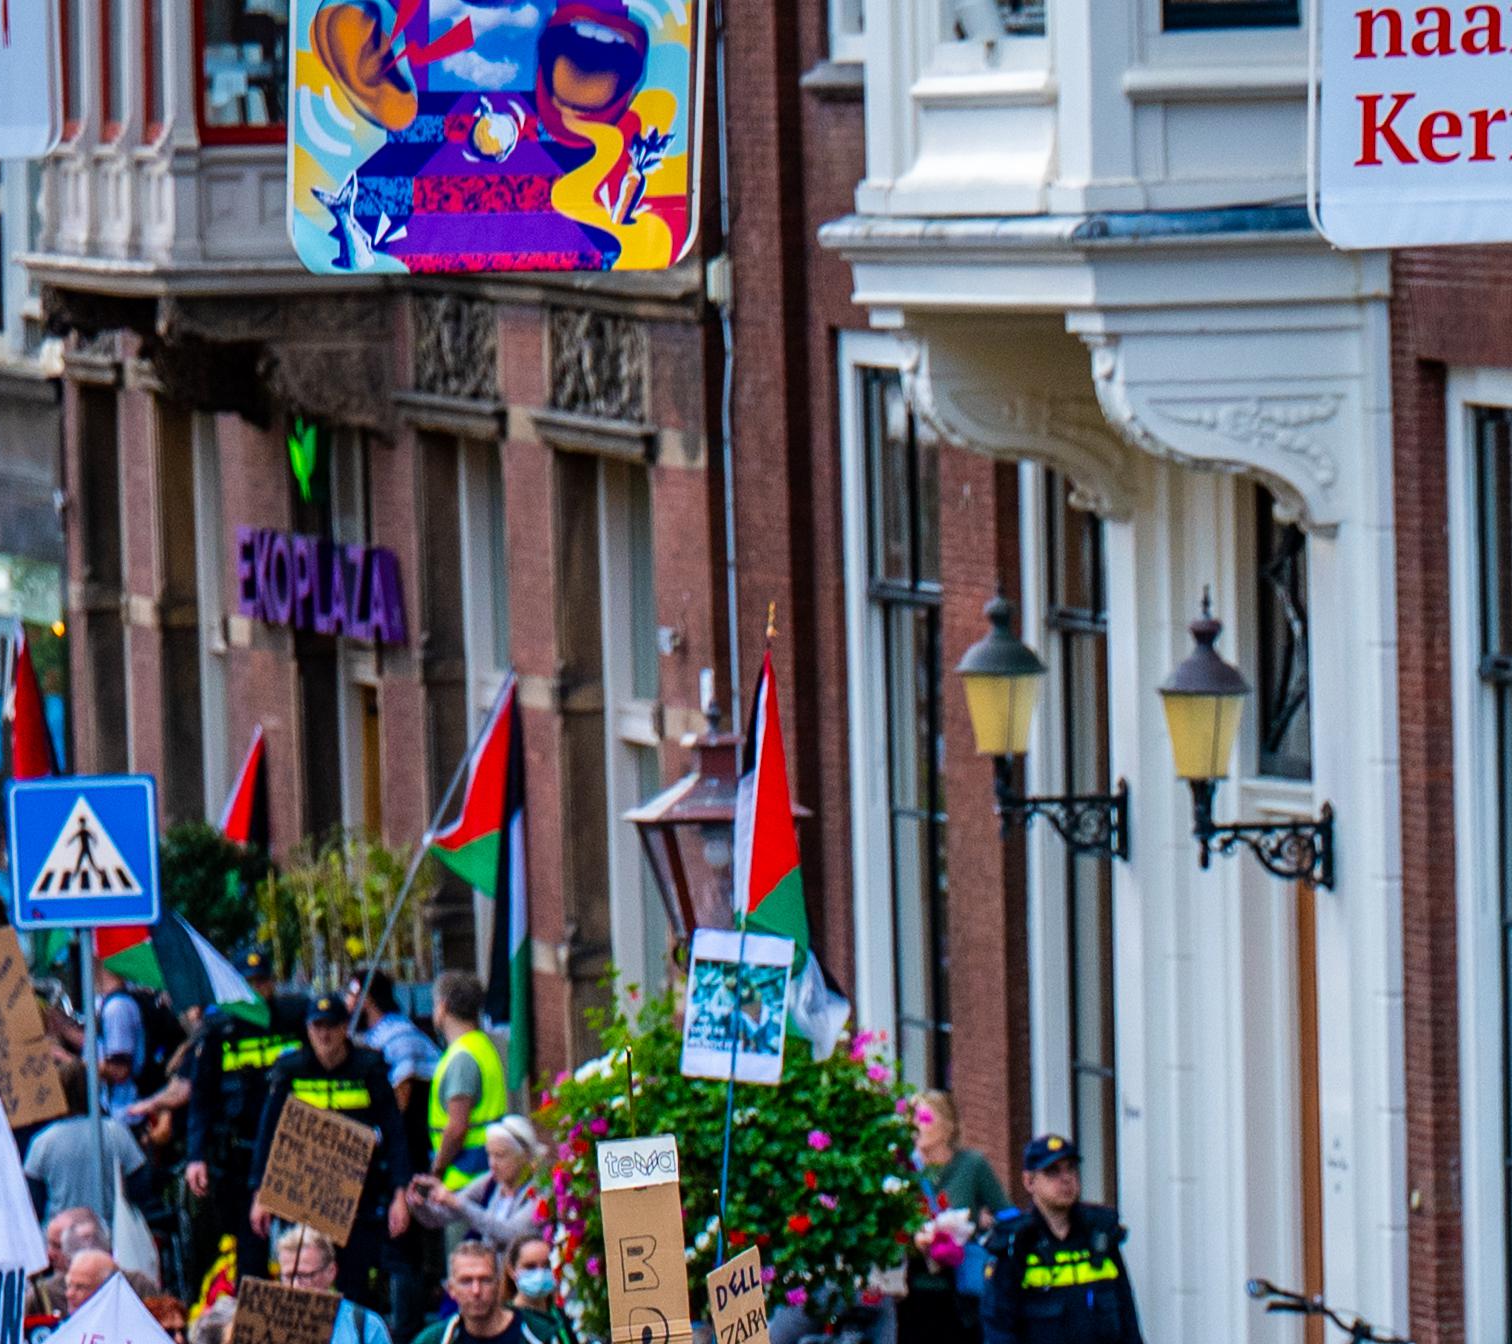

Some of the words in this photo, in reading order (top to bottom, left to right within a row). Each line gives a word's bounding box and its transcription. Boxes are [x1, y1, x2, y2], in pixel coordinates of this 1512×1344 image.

[237, 525, 403, 643] EKOPLAZA
[604, 1149, 676, 1178] teva
[716, 1265, 760, 1312] DELL
